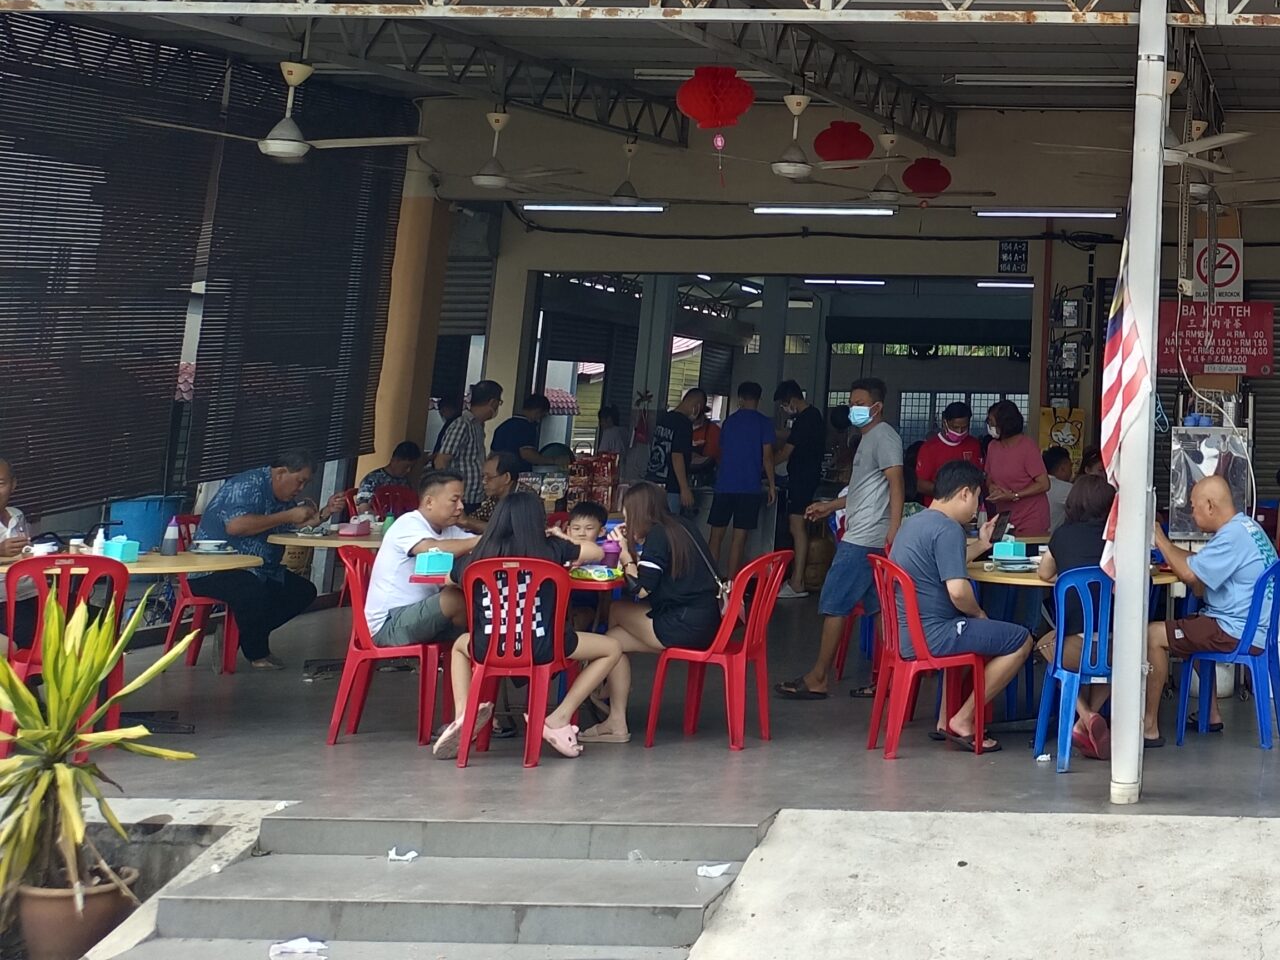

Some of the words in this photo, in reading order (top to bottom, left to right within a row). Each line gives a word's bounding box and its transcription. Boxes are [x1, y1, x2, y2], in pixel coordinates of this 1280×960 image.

[1001, 243, 1013, 251] 164
[1001, 253, 1013, 262] 164
[1000, 264, 1011, 272] 164
[1181, 305, 1196, 317] BA
[1229, 306, 1251, 317] TEH
